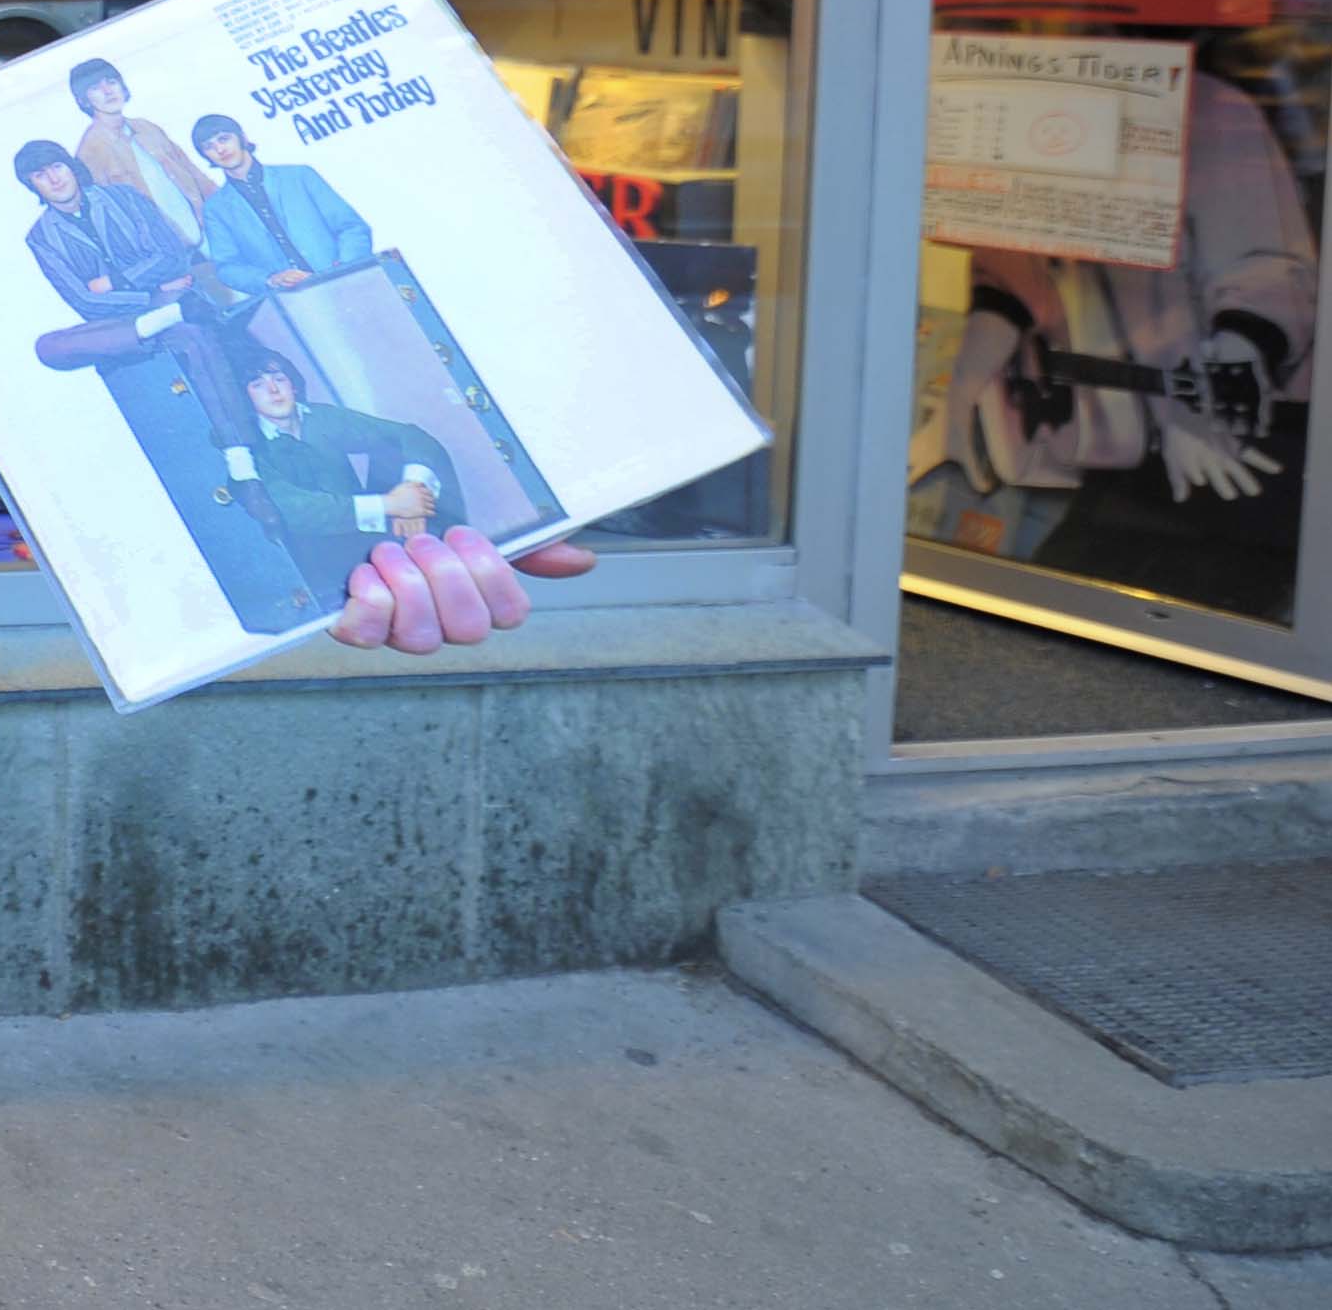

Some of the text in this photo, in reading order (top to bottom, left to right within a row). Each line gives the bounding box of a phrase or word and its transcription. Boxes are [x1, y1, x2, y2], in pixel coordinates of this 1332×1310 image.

[248, 2, 409, 83] The Beatles
[252, 47, 390, 121] Yesterday
[292, 74, 440, 147] And Today
